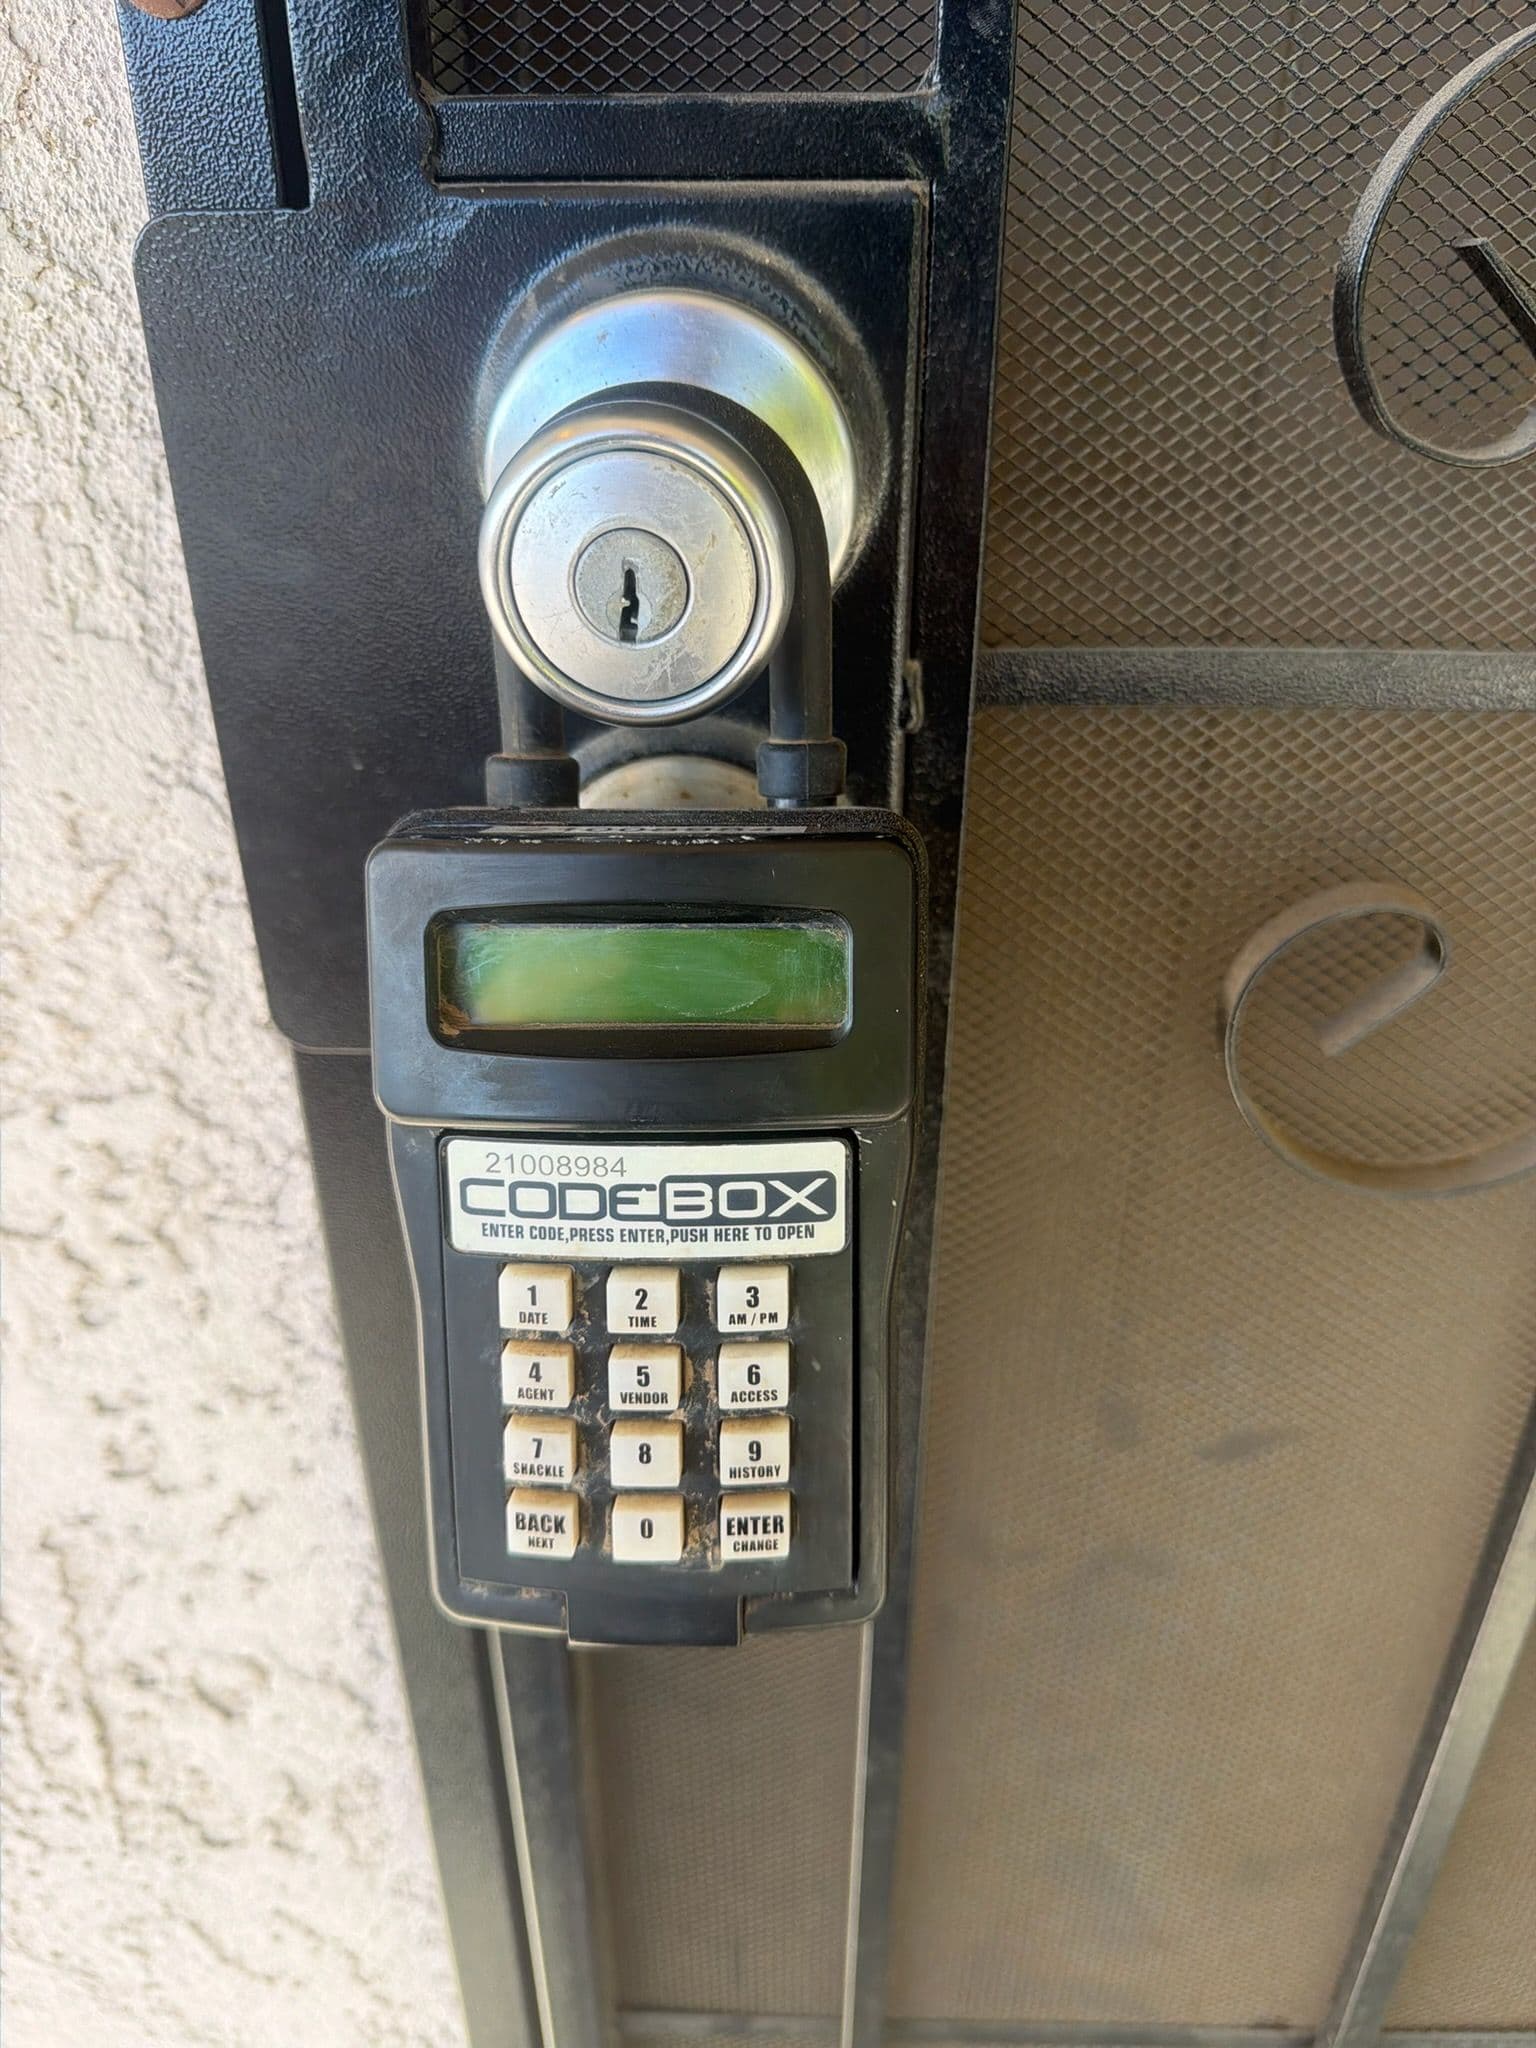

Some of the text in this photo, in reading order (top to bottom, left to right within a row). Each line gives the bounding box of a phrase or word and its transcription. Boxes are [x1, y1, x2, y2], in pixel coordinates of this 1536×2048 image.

[485, 1152, 627, 1178] 21008984
[481, 1222, 525, 1240] ENTER
[713, 1225, 751, 1242] HERE
[754, 1226, 772, 1242] TO
[777, 1224, 815, 1241] OPEN
[527, 1285, 537, 1306] 1
[635, 1288, 648, 1310] 2
[746, 1286, 760, 1308] 3
[519, 1311, 549, 1325] DATE
[628, 1315, 657, 1328] TIME
[529, 1361, 543, 1383] 4
[637, 1366, 650, 1387] 5
[747, 1364, 761, 1386] 6
[517, 1387, 555, 1401] AGENT
[620, 1391, 669, 1405] VENDOR
[730, 1389, 779, 1403] ACCESS
[532, 1438, 543, 1459] 7
[638, 1443, 652, 1465] 8
[748, 1440, 762, 1462] 9
[513, 1462, 565, 1478] SHACKLE
[729, 1465, 781, 1479] HISTORY
[515, 1512, 566, 1534] BACK
[640, 1518, 653, 1539] 0
[726, 1515, 785, 1536] ENTER
[528, 1535, 555, 1549] NEXT
[733, 1540, 779, 1553] CHANGE
